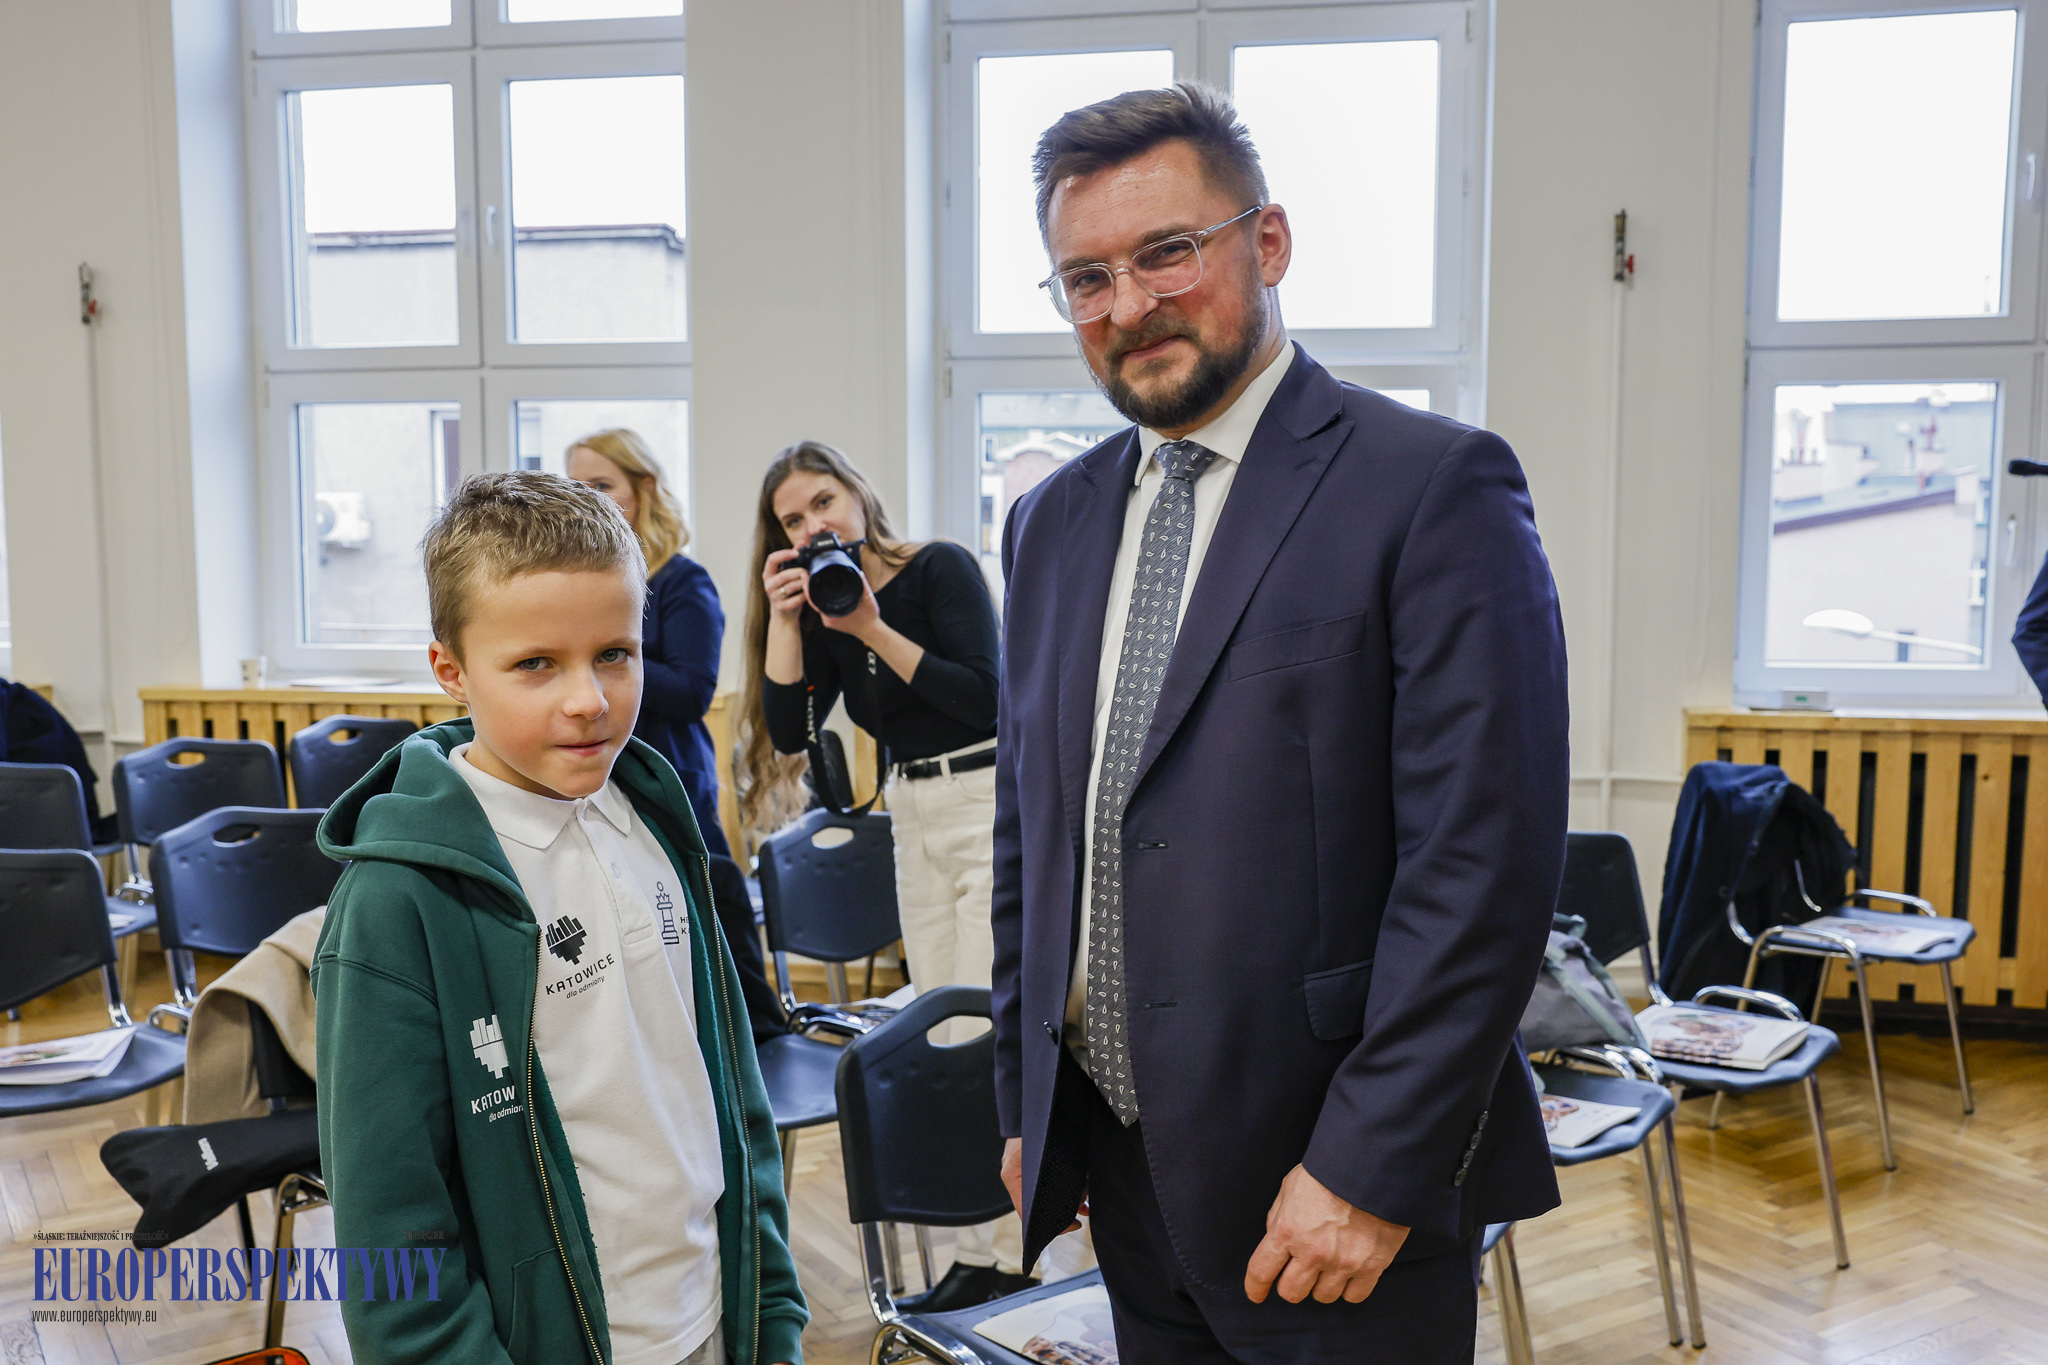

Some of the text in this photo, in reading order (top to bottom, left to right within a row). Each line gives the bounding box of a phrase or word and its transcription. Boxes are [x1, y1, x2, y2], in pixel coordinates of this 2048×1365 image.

[545, 953, 615, 995] KATOWICE
[566, 975, 605, 999] dla odmiany
